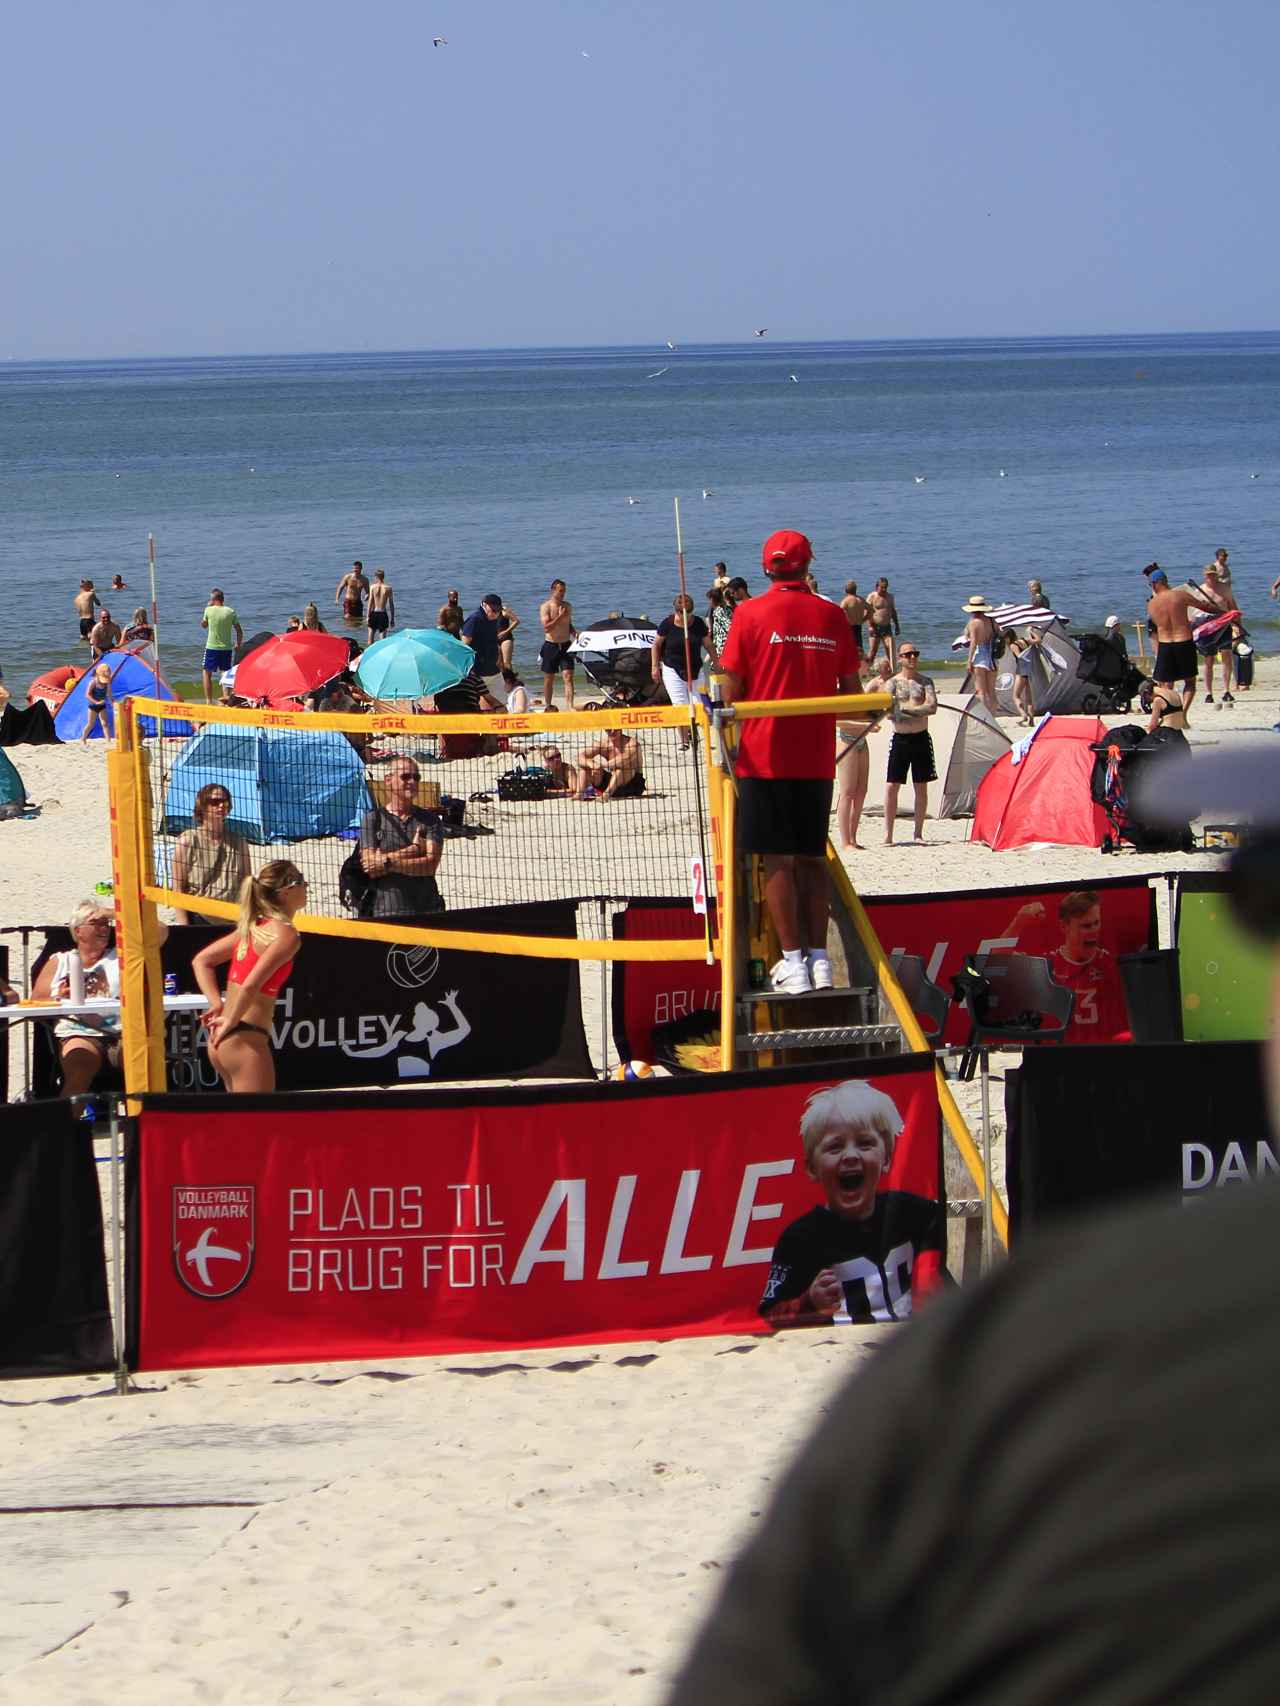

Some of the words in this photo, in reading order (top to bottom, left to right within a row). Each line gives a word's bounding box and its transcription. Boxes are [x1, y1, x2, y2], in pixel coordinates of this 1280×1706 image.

[613, 632, 656, 645] PING
[692, 863, 704, 904] 2
[655, 980, 721, 1024] BRU
[1075, 988, 1098, 1025] 3
[178, 1190, 249, 1204] VOLLEYBALL
[178, 1204, 249, 1220] DANMARK
[288, 1186, 423, 1232] PLADS
[447, 1183, 505, 1227] TIL
[510, 1158, 796, 1285] ALLE
[287, 1247, 403, 1292] BRUG
[423, 1244, 507, 1288] FOR
